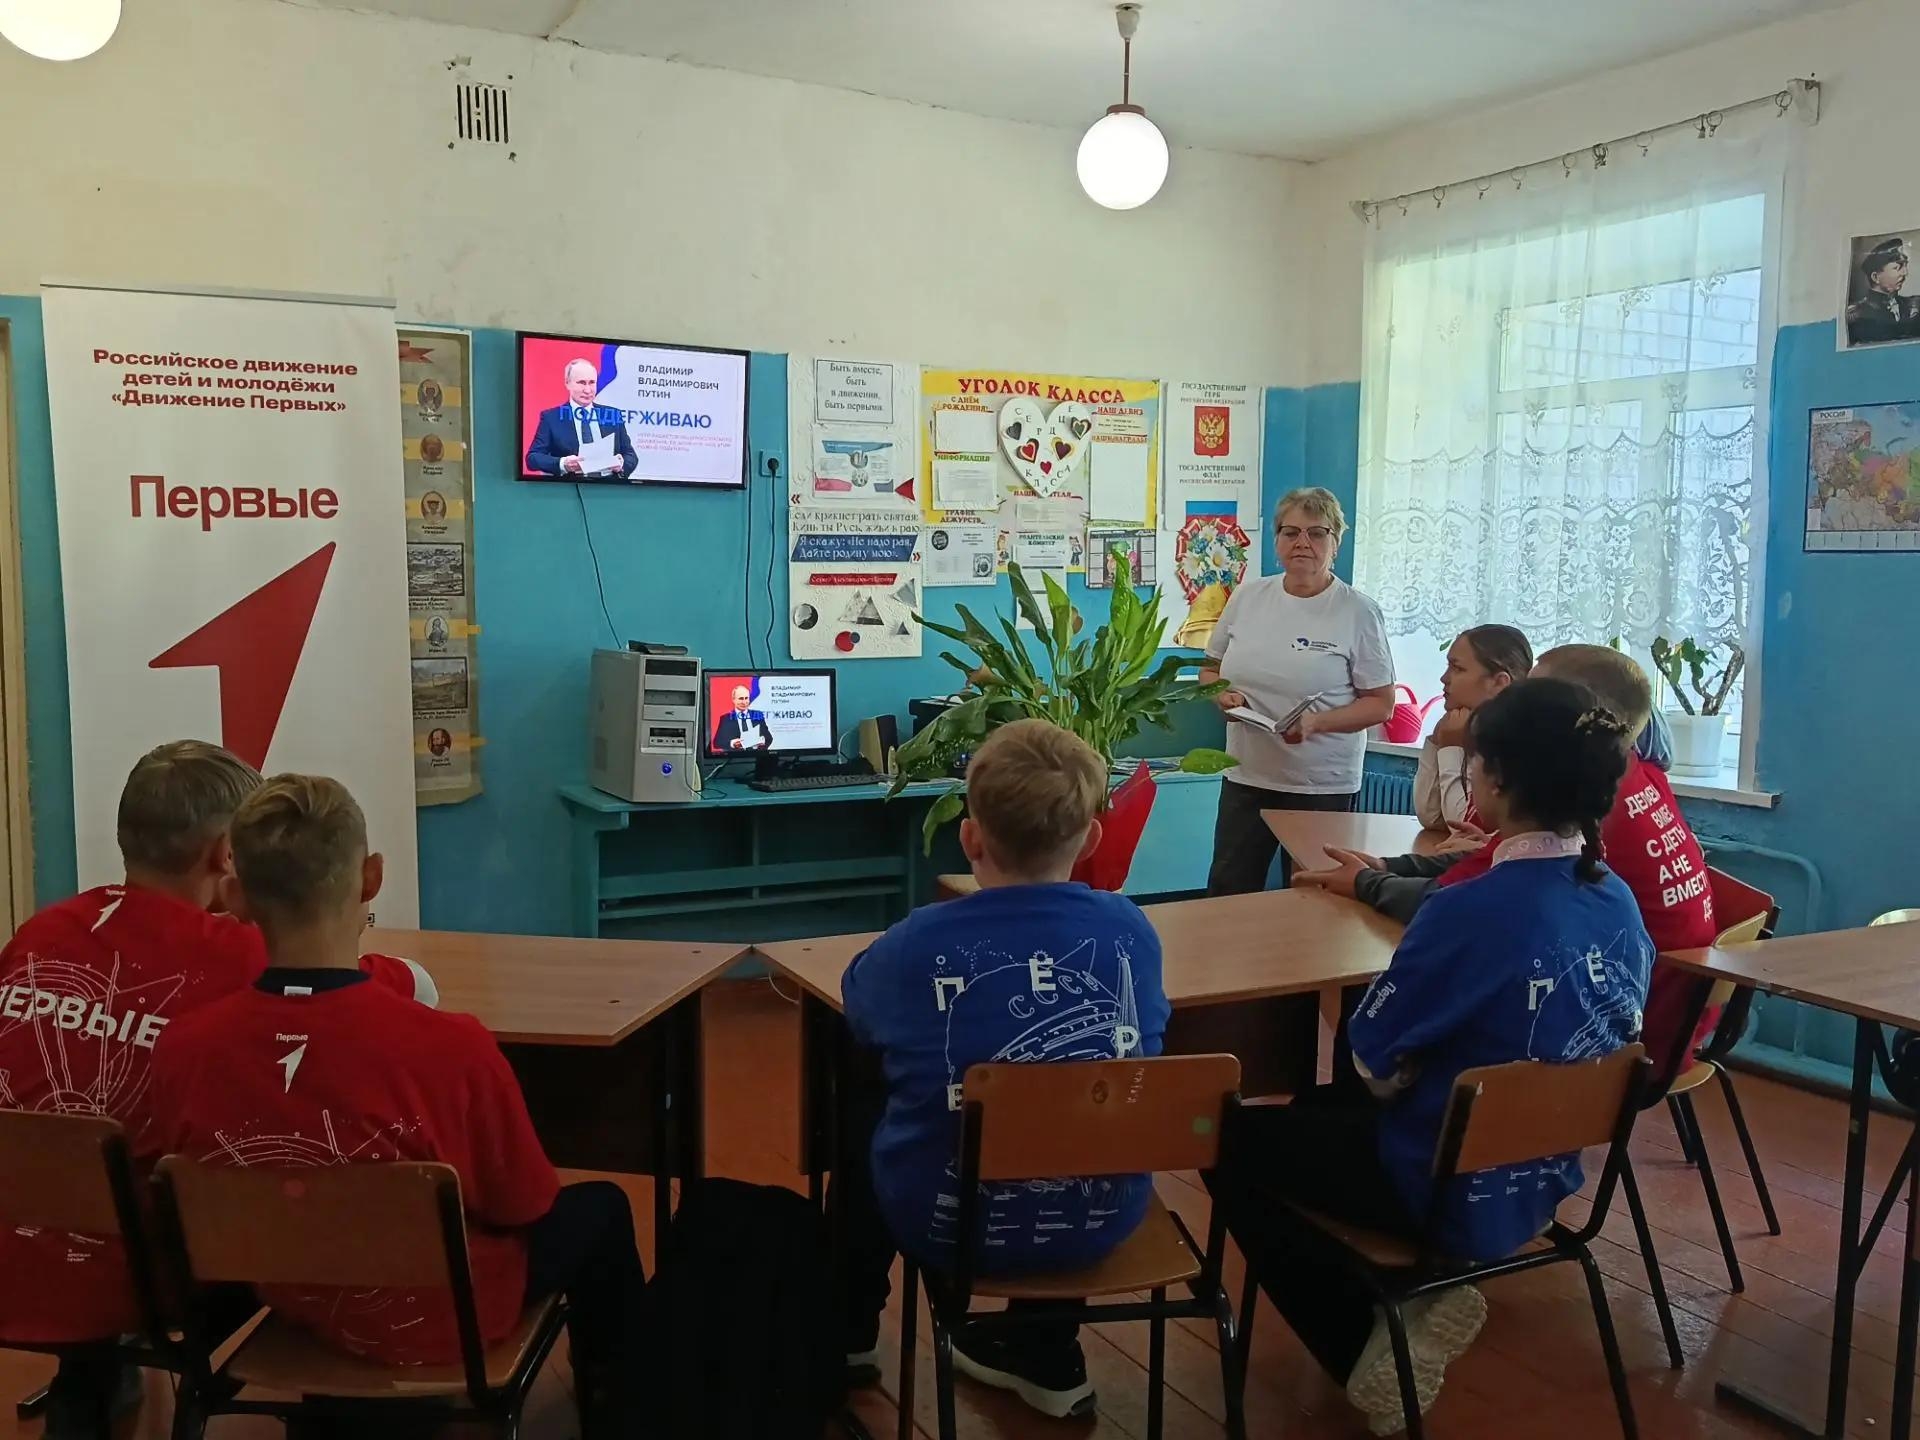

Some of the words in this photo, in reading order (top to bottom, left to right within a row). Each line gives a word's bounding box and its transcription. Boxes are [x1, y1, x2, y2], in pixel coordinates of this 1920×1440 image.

[93, 348, 238, 370] Российское
[243, 359, 358, 376] движение
[638, 364, 693, 376] ВЛАДИМИР
[122, 371, 193, 388] детей
[198, 375, 212, 387] и
[217, 376, 335, 394] молодёжи
[638, 377, 719, 390] ВЛАДИМИРОВИЧ
[846, 376, 866, 386] быть
[958, 378, 1041, 397] УГОЛОК
[1047, 384, 1125, 403] КЛАССА
[111, 388, 245, 408] «Движение
[250, 394, 346, 413] Первых»
[638, 389, 671, 399] ПУТИН
[825, 400, 845, 409] быть
[560, 405, 712, 429] ПОДДЕРЖИВАЮ
[130, 474, 340, 532] Первые
[1646, 839, 1662, 858] С
[1659, 864, 1674, 884] А
[1672, 854, 1693, 878] НЕ
[1366, 981, 1397, 1018] Первые
[276, 1033, 309, 1043] Первые
